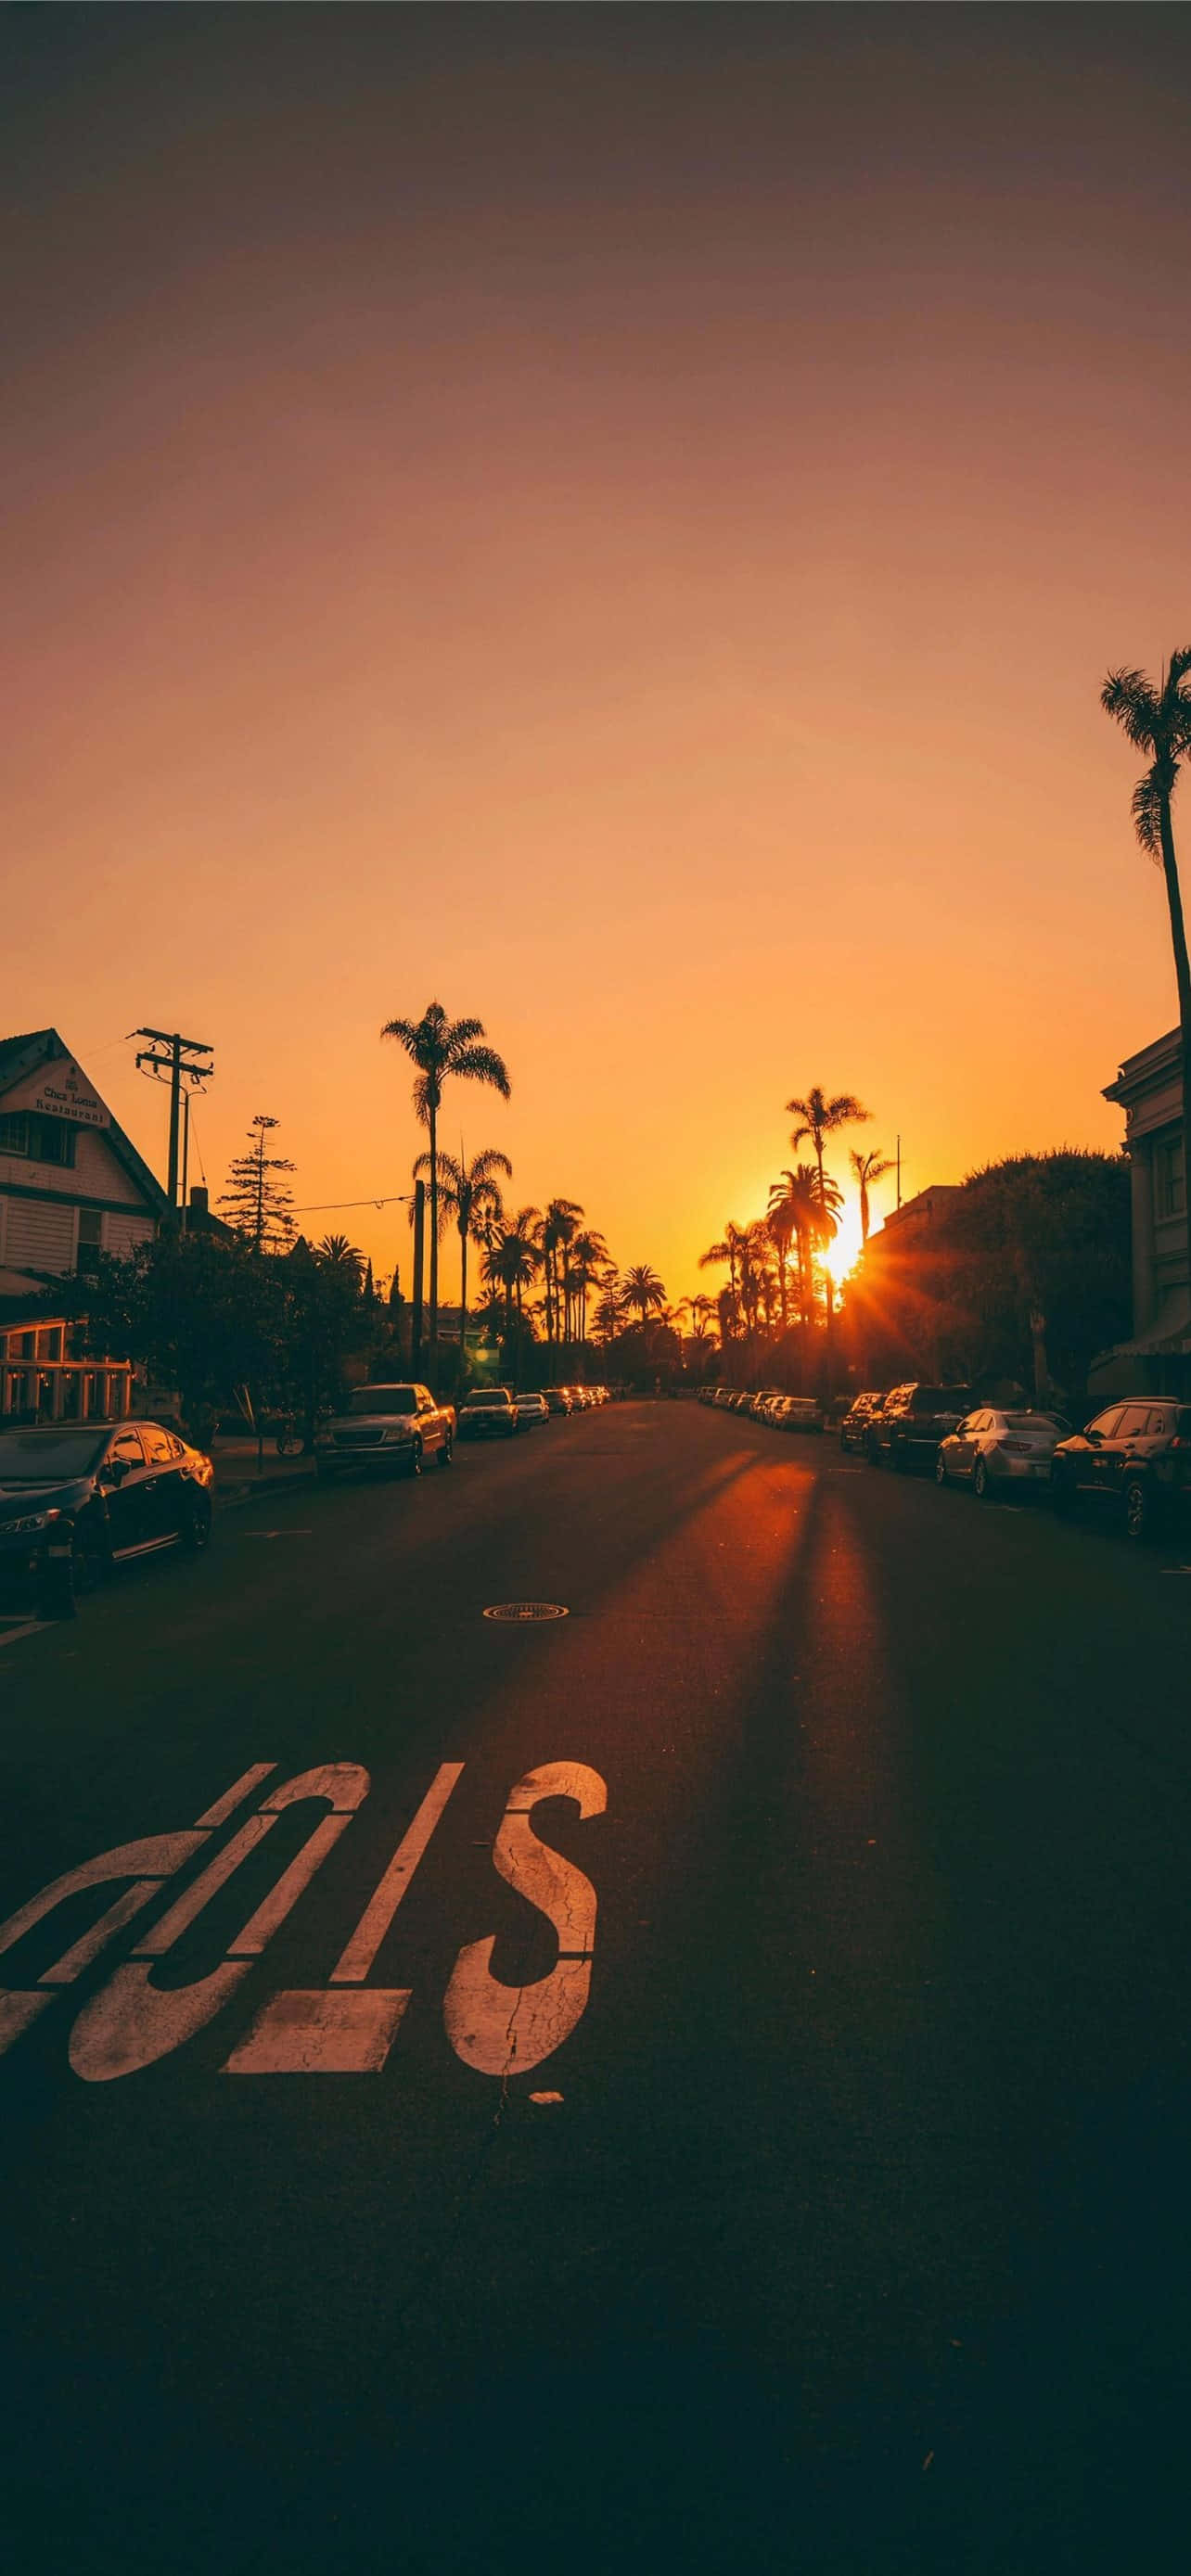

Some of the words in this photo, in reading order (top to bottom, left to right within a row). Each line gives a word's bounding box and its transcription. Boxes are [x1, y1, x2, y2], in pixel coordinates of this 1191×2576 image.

[44, 1086, 68, 1102] Chez
[36, 1098, 104, 1123] Restaurant
[0, 1761, 608, 2082] STOP
